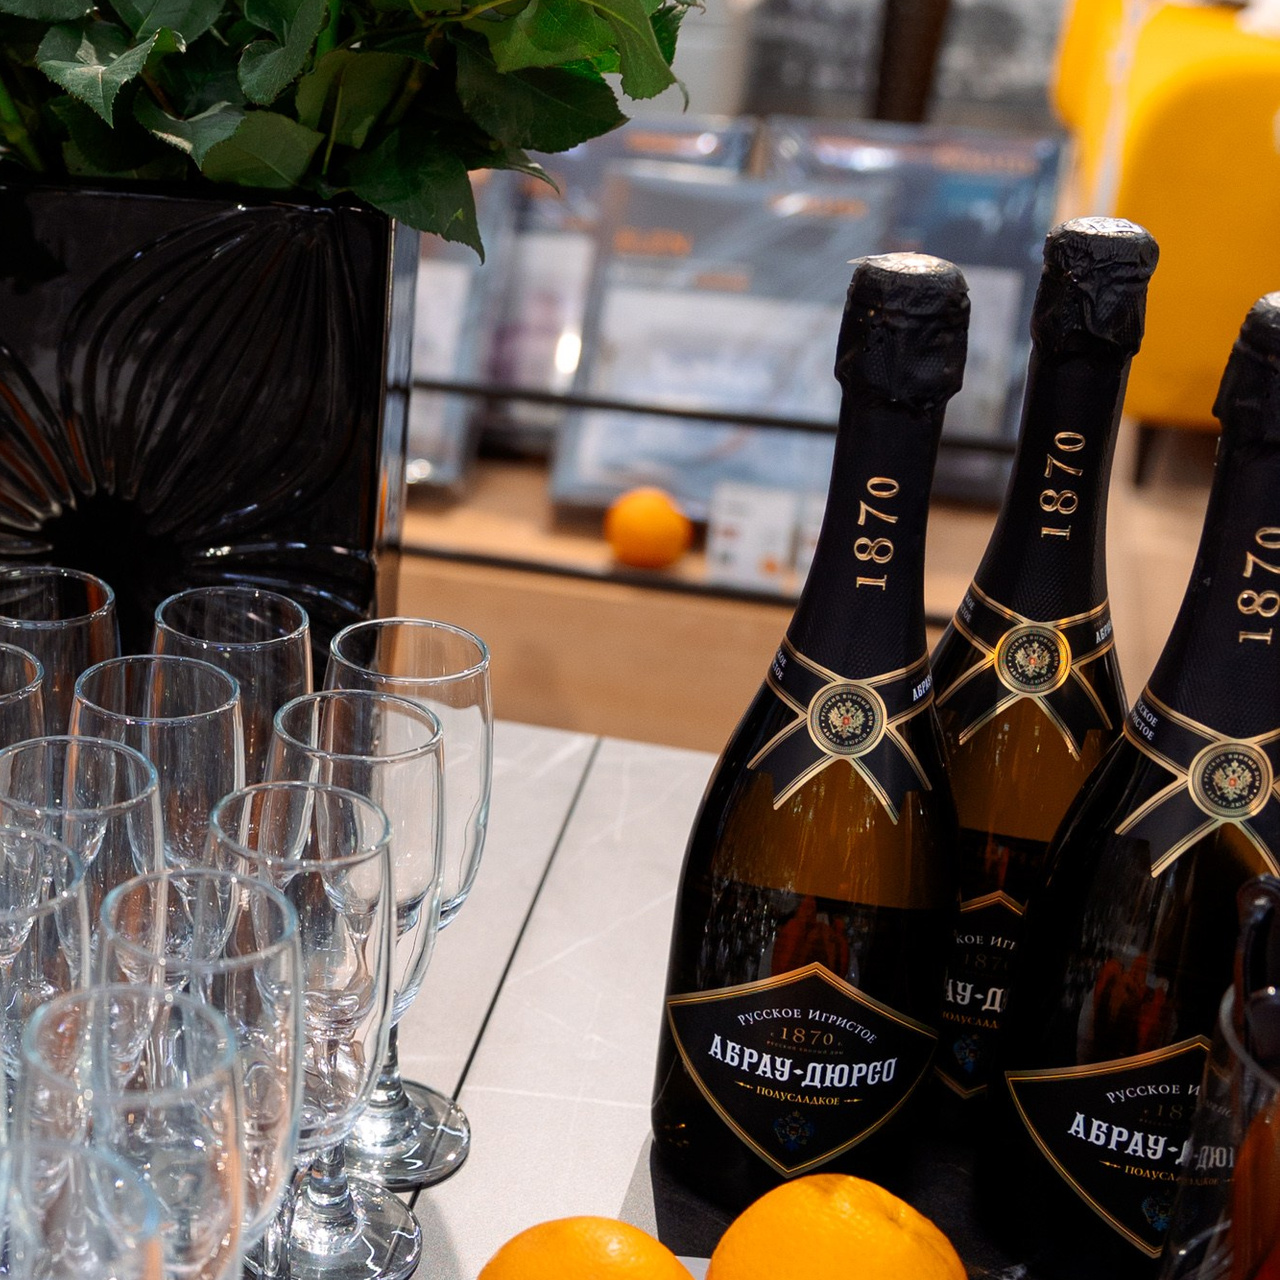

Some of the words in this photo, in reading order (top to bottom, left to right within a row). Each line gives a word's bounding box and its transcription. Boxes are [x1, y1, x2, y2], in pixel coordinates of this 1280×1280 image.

[1039, 431, 1087, 541] 1870
[853, 476, 901, 591] 1870
[1236, 526, 1280, 646] 1870
[737, 1008, 802, 1026] РУССКОЕ
[808, 1009, 877, 1045] ИГРИСТОЕ
[780, 1027, 834, 1046] 1870
[708, 1032, 898, 1089] АБРАУ-ДЮРСО
[756, 1085, 840, 1106] ПОЛУСЛАДКОЕ
[1105, 1084, 1181, 1104] РУССКОЕ
